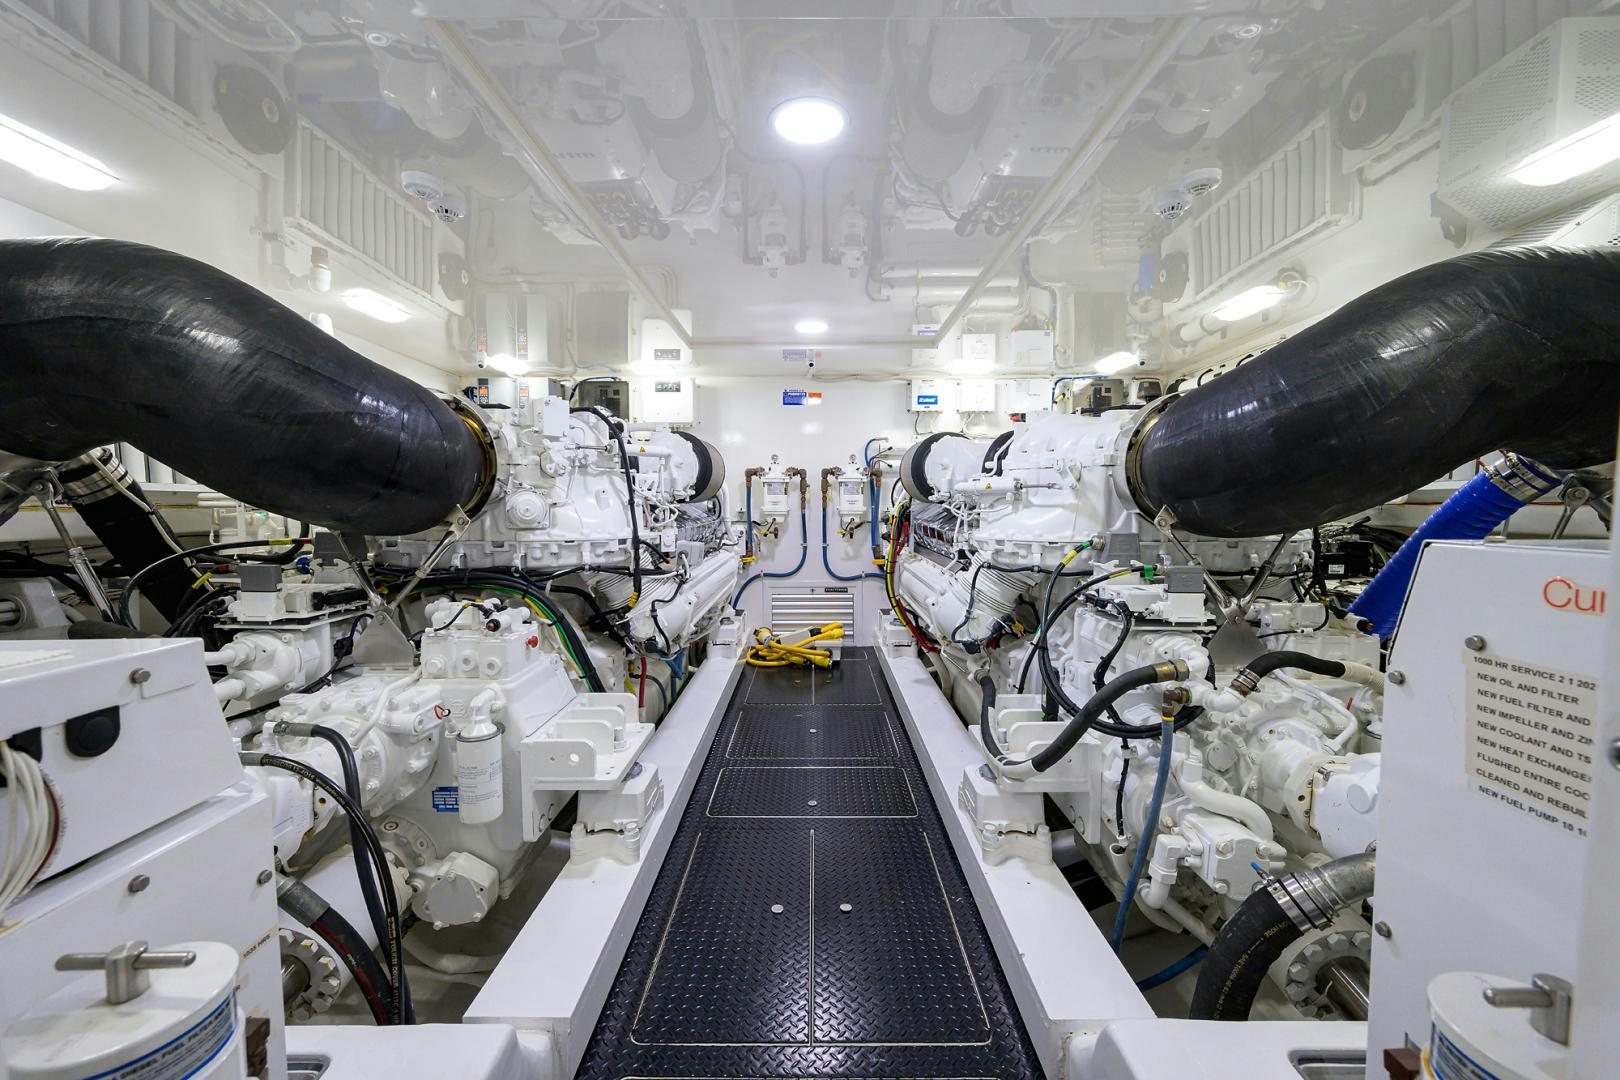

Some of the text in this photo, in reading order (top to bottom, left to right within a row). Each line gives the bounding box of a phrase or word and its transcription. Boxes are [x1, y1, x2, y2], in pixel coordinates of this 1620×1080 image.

[1544, 578, 1606, 613] Cu
[1474, 656, 1493, 666] 1000
[1495, 660, 1508, 670] HR
[1511, 665, 1556, 681] SERVICE
[1477, 673, 1580, 704] NEW OIL AND FILTER
[1477, 689, 1591, 726] NEW FUEL FILTER AND
[1477, 704, 1496, 715] NEW
[1499, 711, 1548, 732] IMPELLER
[1551, 728, 1574, 740] AND
[1477, 720, 1497, 732] NEW
[1499, 728, 1547, 748] COOLANT
[1550, 745, 1573, 758] AND
[1477, 736, 1497, 748] NEW
[1499, 744, 1524, 758] HEAT
[1476, 768, 1520, 791] CLEANED
[1523, 787, 1544, 801] AND
[1477, 752, 1521, 774] FLUSHED
[1524, 770, 1561, 790] ENTIRE
[1479, 786, 1498, 798] NEW
[1501, 795, 1526, 811] FUEL
[1528, 807, 1559, 823] PUMP
[1563, 822, 1574, 831] 10
[162, 1042, 186, 1059] FUEL
